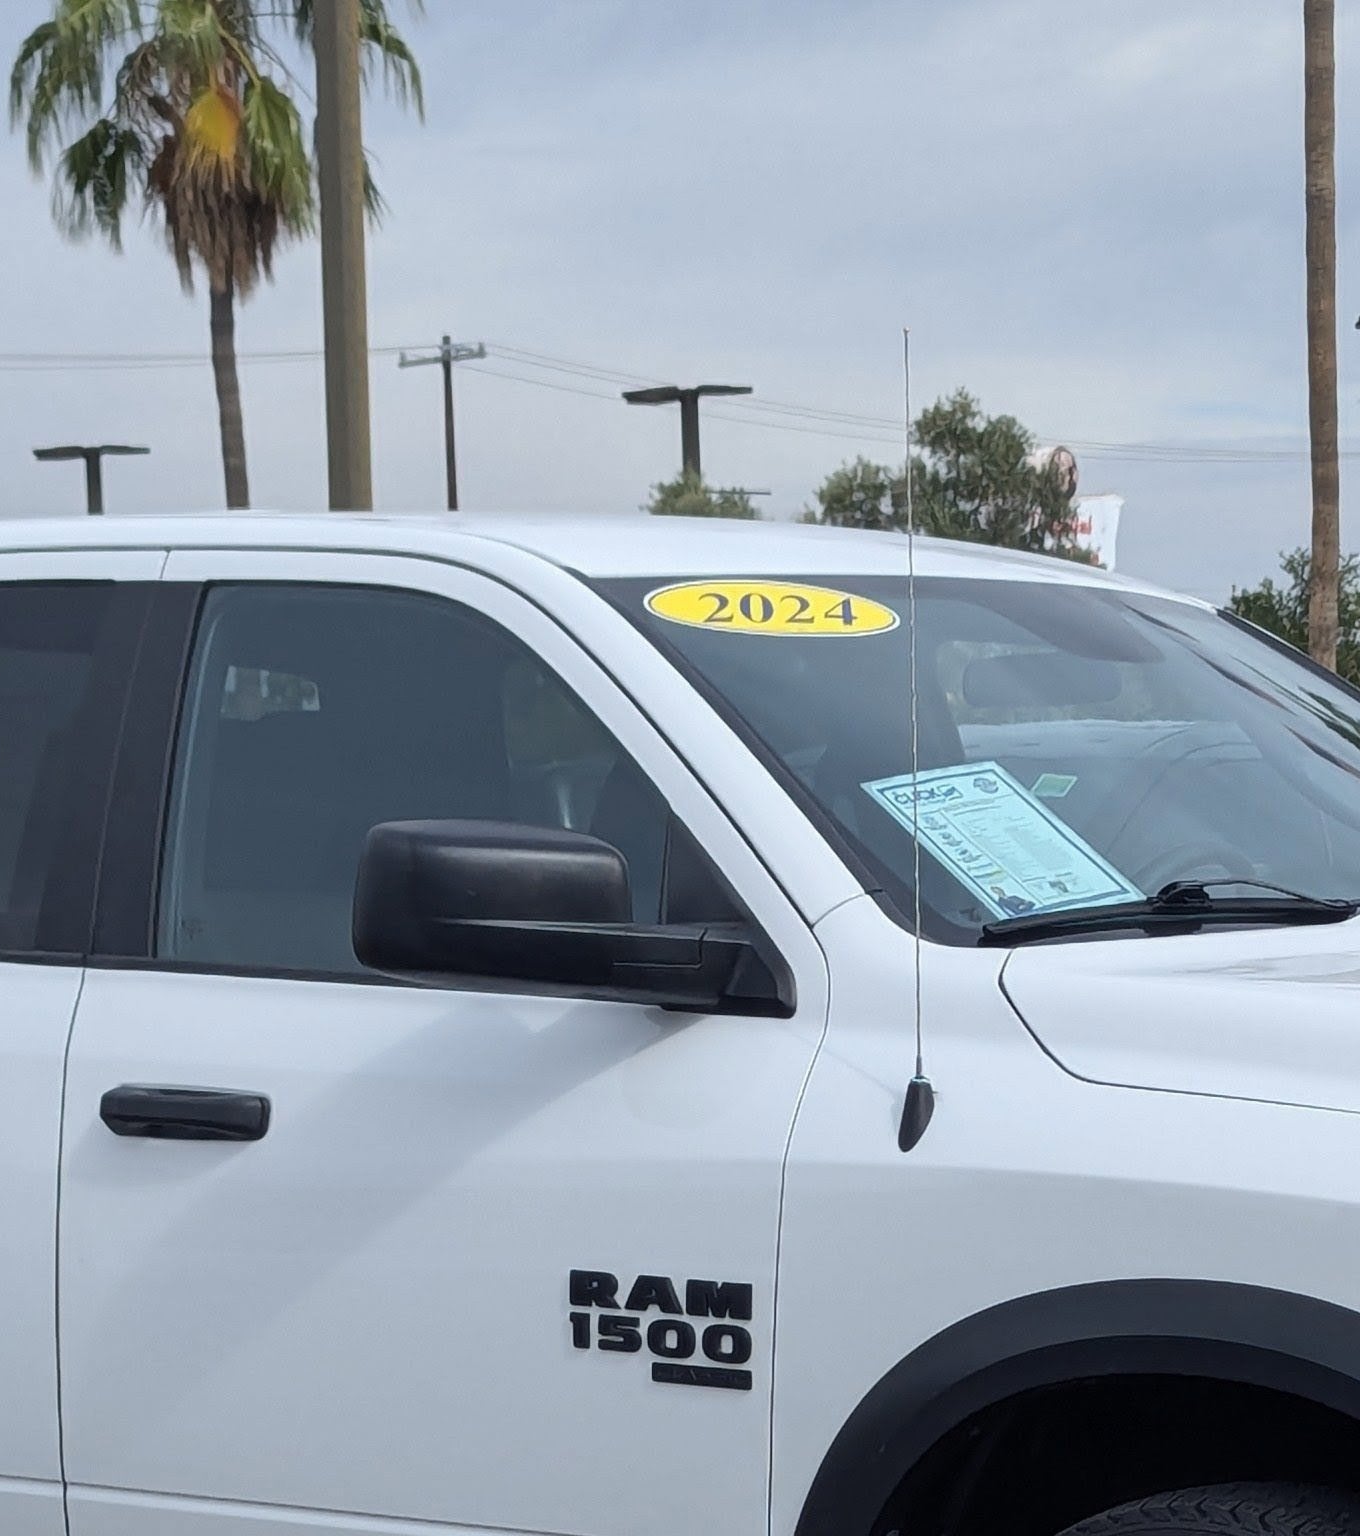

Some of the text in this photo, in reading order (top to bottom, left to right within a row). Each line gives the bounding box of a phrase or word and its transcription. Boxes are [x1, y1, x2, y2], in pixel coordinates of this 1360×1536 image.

[698, 592, 858, 626] 2024
[569, 1269, 753, 1321] RAM
[569, 1311, 753, 1364] 1500
